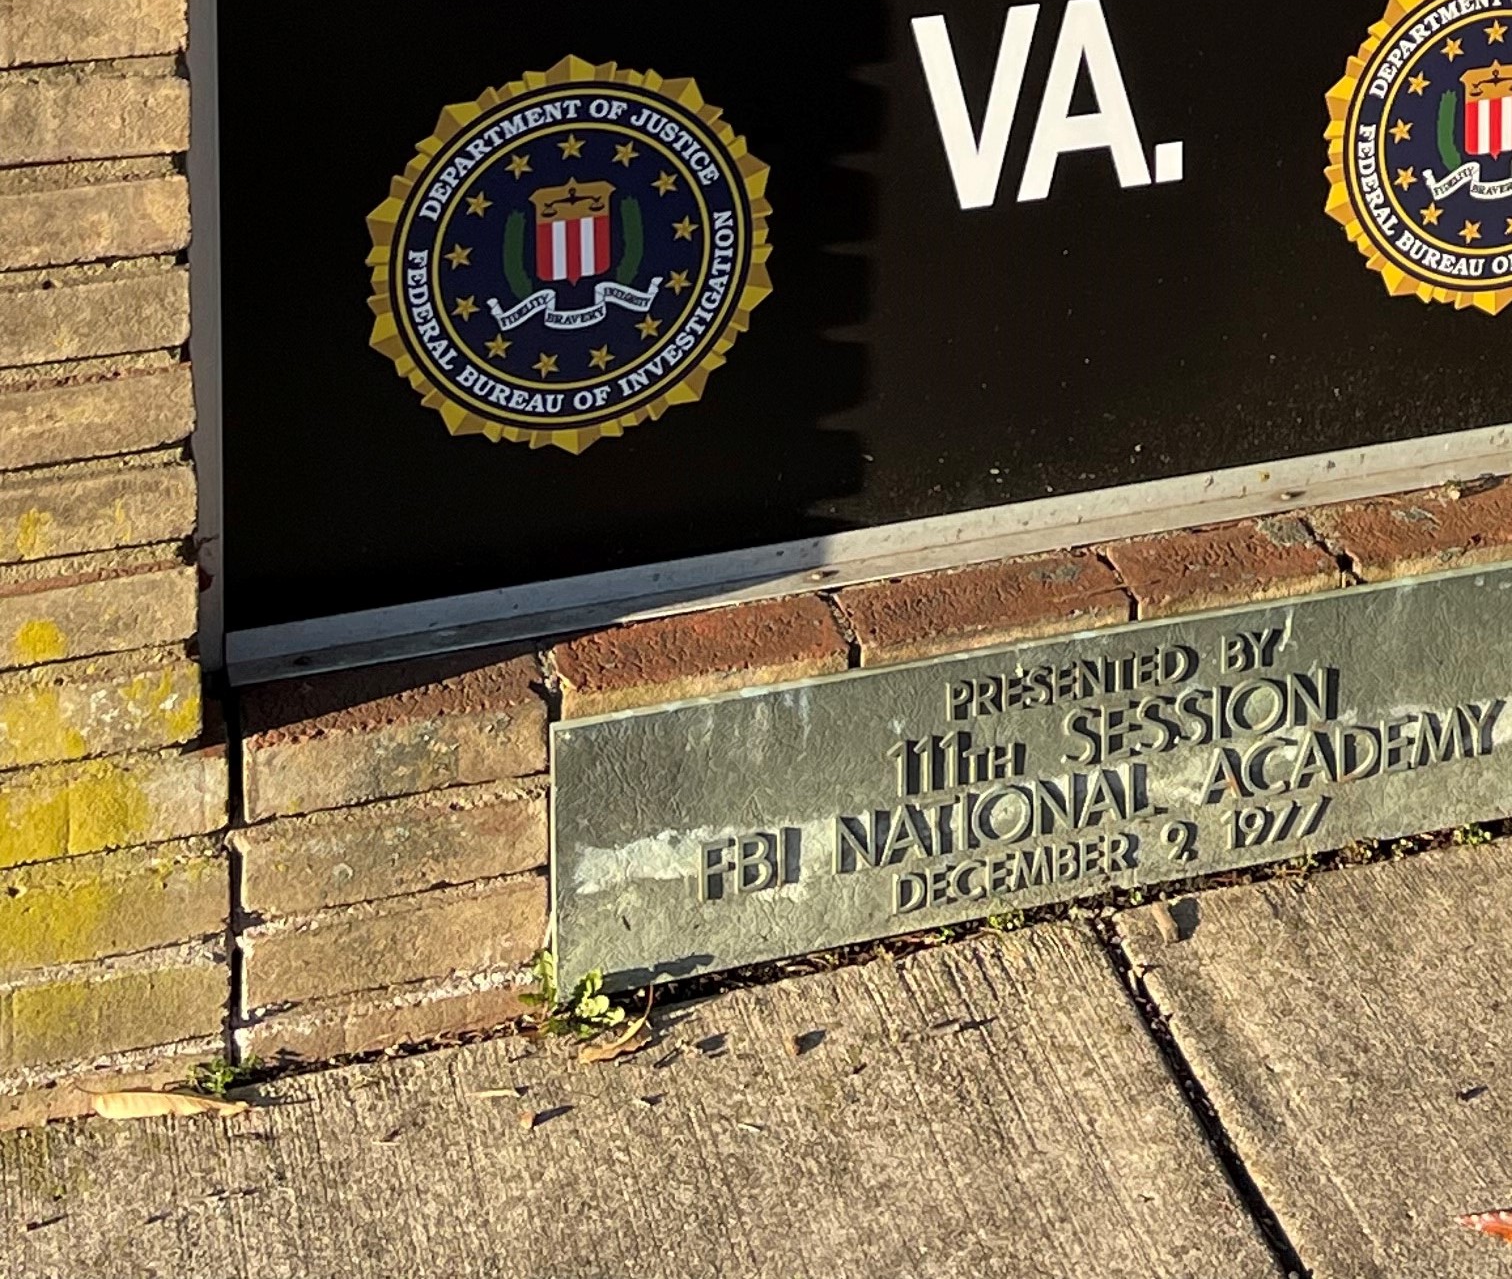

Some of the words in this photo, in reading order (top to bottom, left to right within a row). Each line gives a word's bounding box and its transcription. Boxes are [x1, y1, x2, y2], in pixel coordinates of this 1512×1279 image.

[418, 98, 581, 223] DEPARTMENT
[588, 98, 628, 121] OF
[629, 107, 720, 187] JUSTICE
[1357, 122, 1397, 236] FEDERAL
[1395, 233, 1484, 277] BUREAU
[407, 248, 454, 371] FEDERAL
[455, 363, 565, 413] BUREAU
[572, 385, 611, 411] OF
[619, 209, 735, 397] INVESTIGATION
[945, 643, 1197, 722] PRESENTED
[1219, 628, 1283, 675] BY
[1060, 665, 1340, 766] SESSION
[699, 827, 802, 902] FBI
[832, 762, 1168, 876] NATIONAL
[1201, 698, 1506, 805] ACADEMY
[892, 832, 1138, 916] DECEMBER
[1219, 794, 1332, 851] 1977
